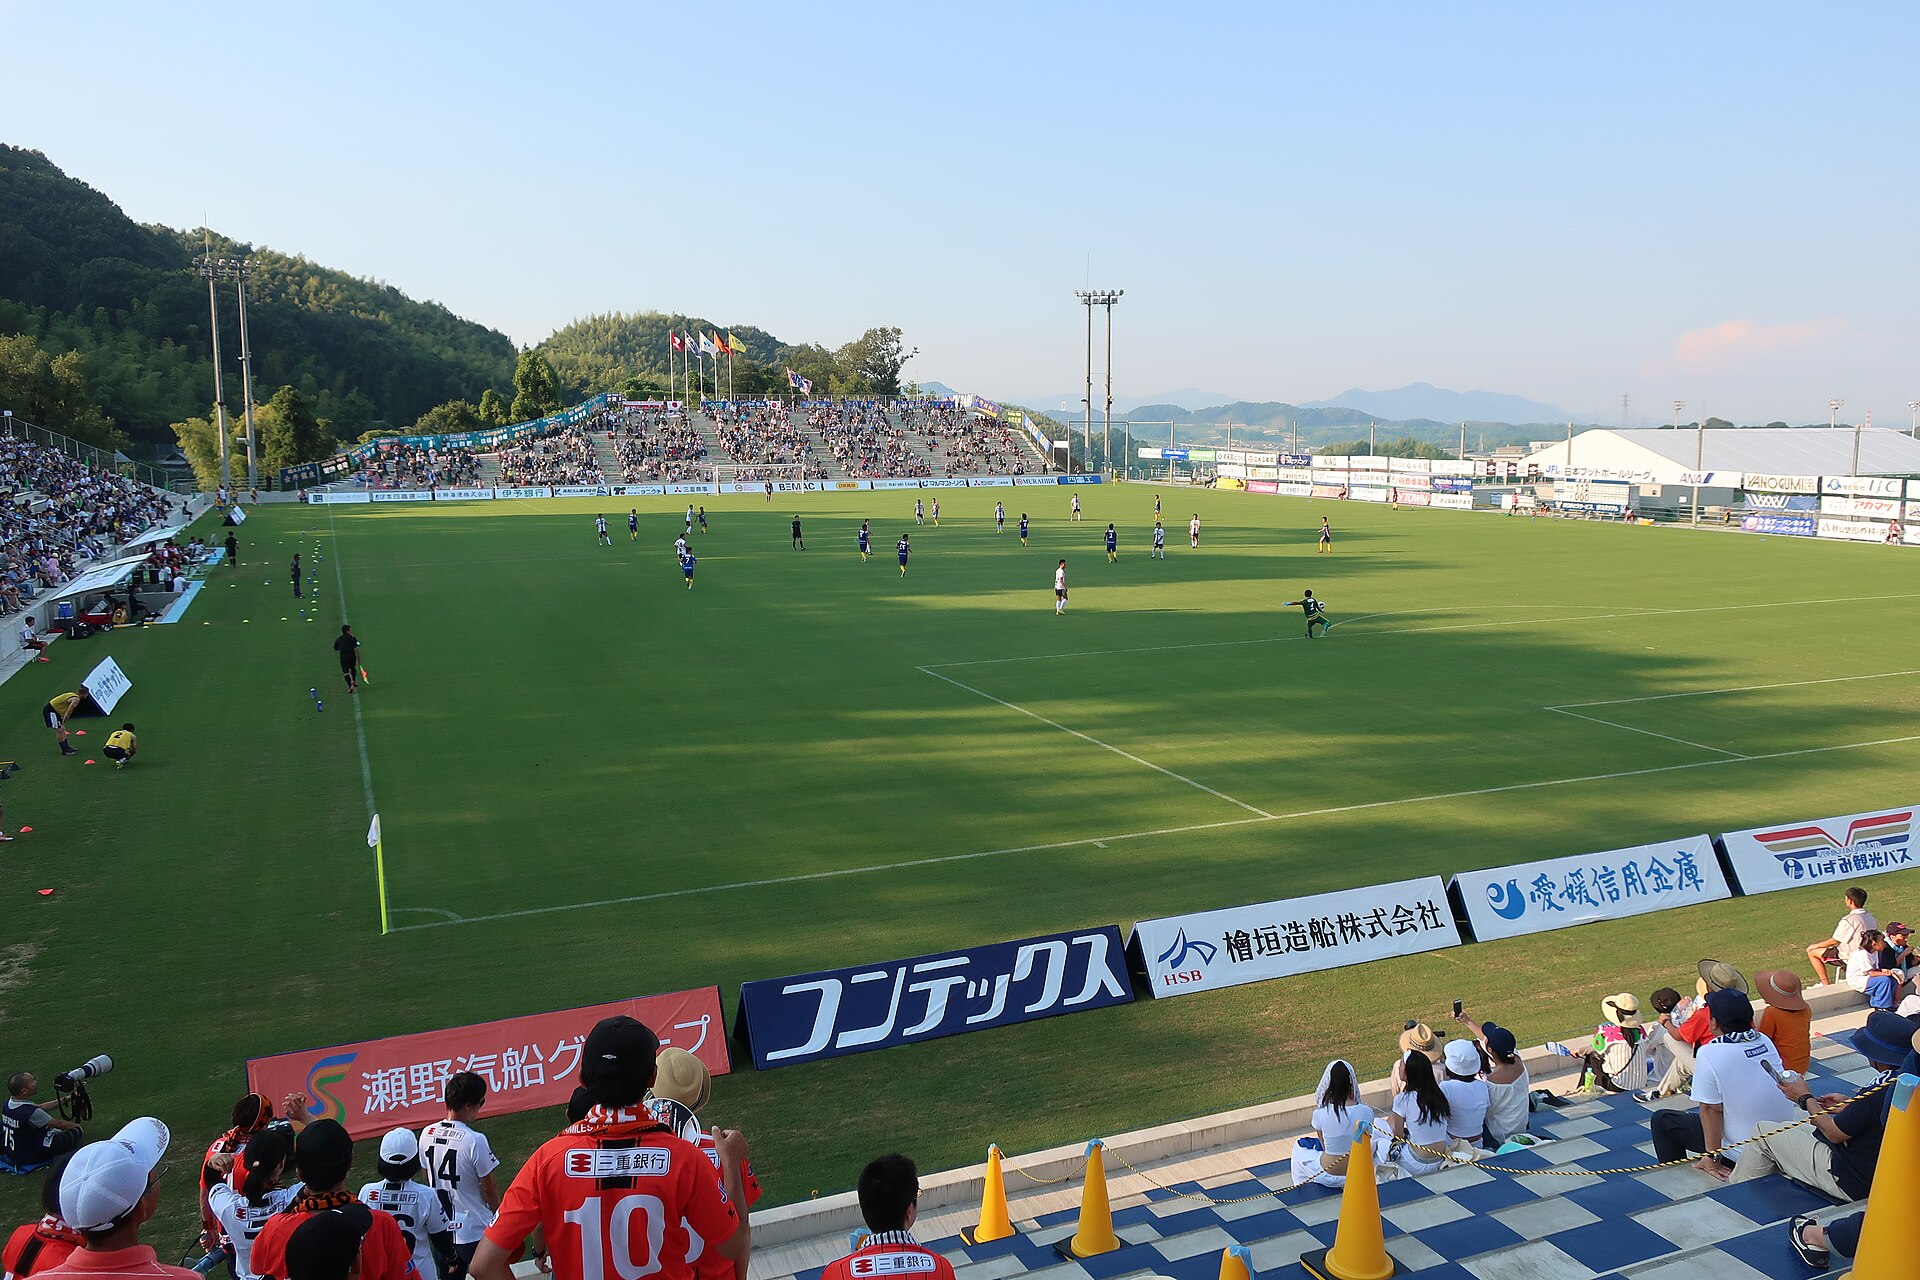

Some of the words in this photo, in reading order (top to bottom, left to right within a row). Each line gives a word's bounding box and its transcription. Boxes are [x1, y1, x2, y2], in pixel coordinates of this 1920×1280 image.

[1545, 465, 1559, 474] JFL
[1565, 467, 1651, 480] 日本フットボールリーグ
[1679, 473, 1703, 484] ANA
[1747, 475, 1805, 491] YANOGUMI
[501, 489, 544, 498] 伊予銀行
[778, 482, 816, 491] BEMAC
[1854, 500, 1894, 511] アカマツ
[1808, 848, 1913, 878] いずみ観光バス
[1529, 850, 1705, 913] 愛媛信用金庫
[1223, 899, 1446, 964] 檜垣造船株式会社
[1164, 970, 1203, 986] HSB
[766, 934, 1124, 1062] コンテックス
[436, 1127, 465, 1141] 三重銀行
[425, 1145, 461, 1190] 14
[597, 1153, 666, 1172] 三重銀行
[381, 1192, 417, 1204] 三重銀行
[563, 1195, 667, 1280] 10
[879, 1256, 932, 1270] 三重銀行
